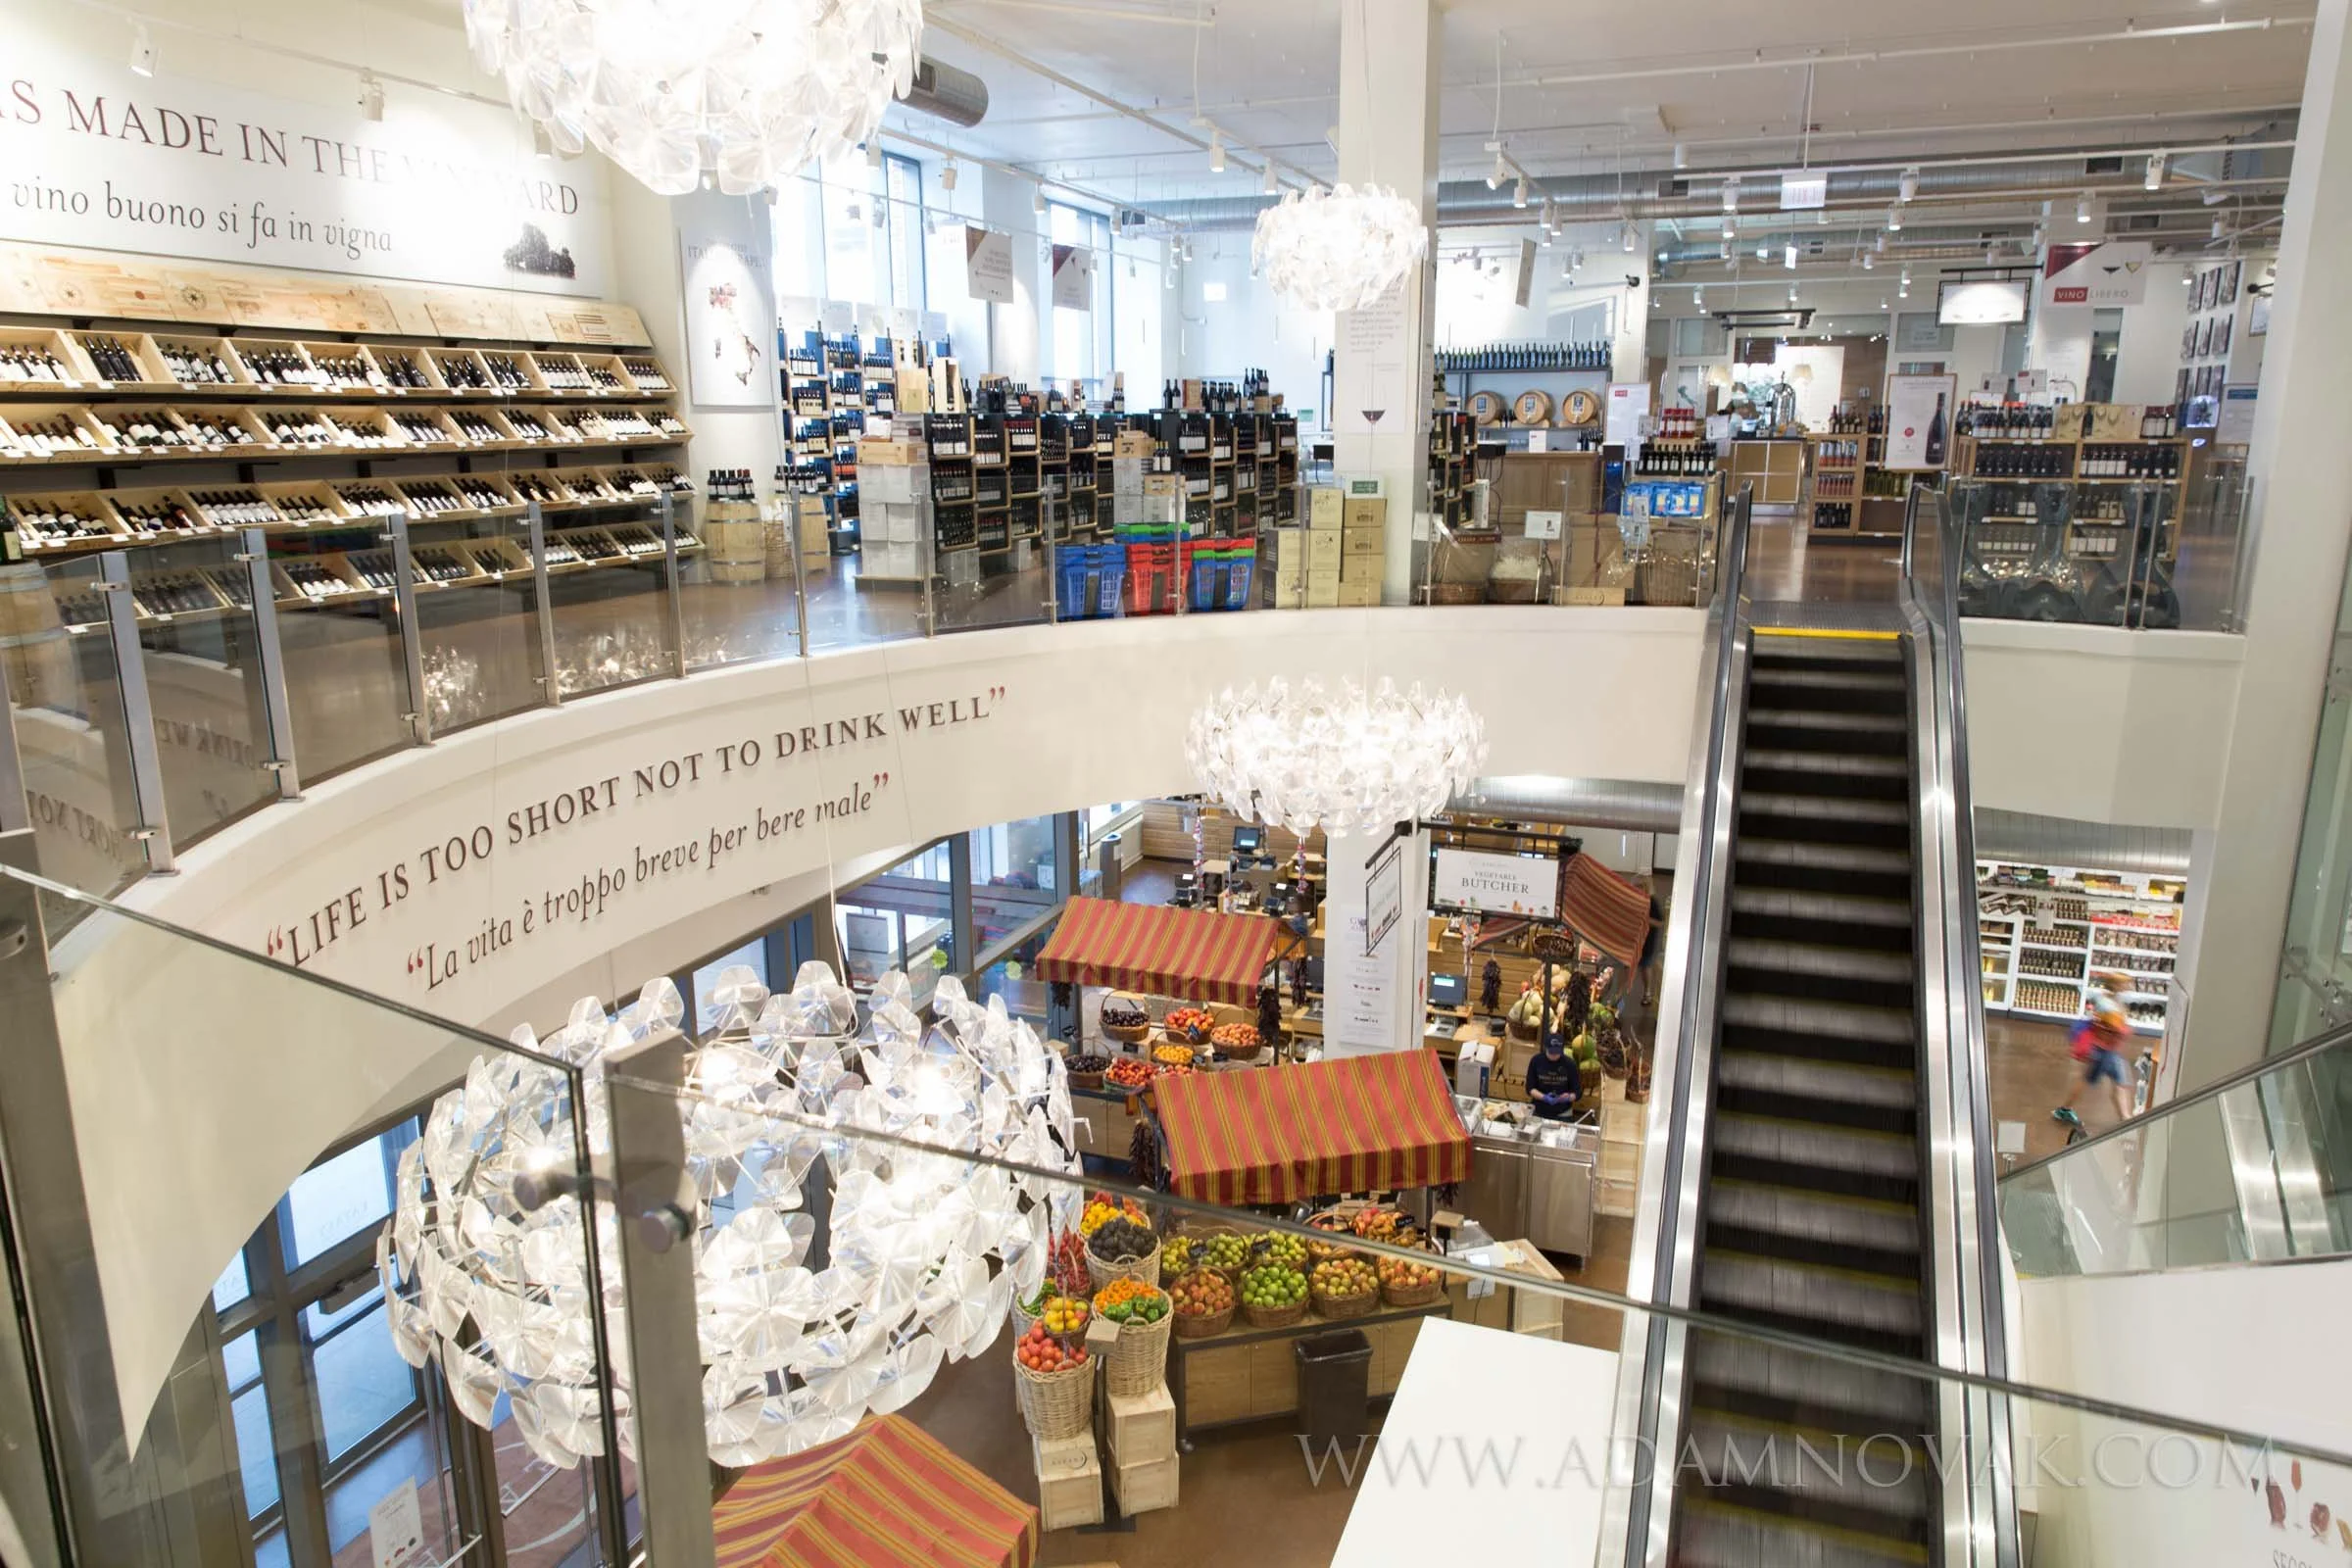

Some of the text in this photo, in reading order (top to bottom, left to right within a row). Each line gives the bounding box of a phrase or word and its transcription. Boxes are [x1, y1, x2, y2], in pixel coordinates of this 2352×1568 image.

[0, 79, 579, 215] S MADE IN THE VNARD
[12, 175, 392, 261] vino buono si fa in vigna
[2057, 289, 2085, 300] VINO
[268, 686, 1005, 967] “LIFE IS TOO SHORT NOT TO DRINK WELL”
[408, 771, 889, 991] “La vita è troppo breve per bere male”
[1461, 877, 1530, 895] BUTCHER
